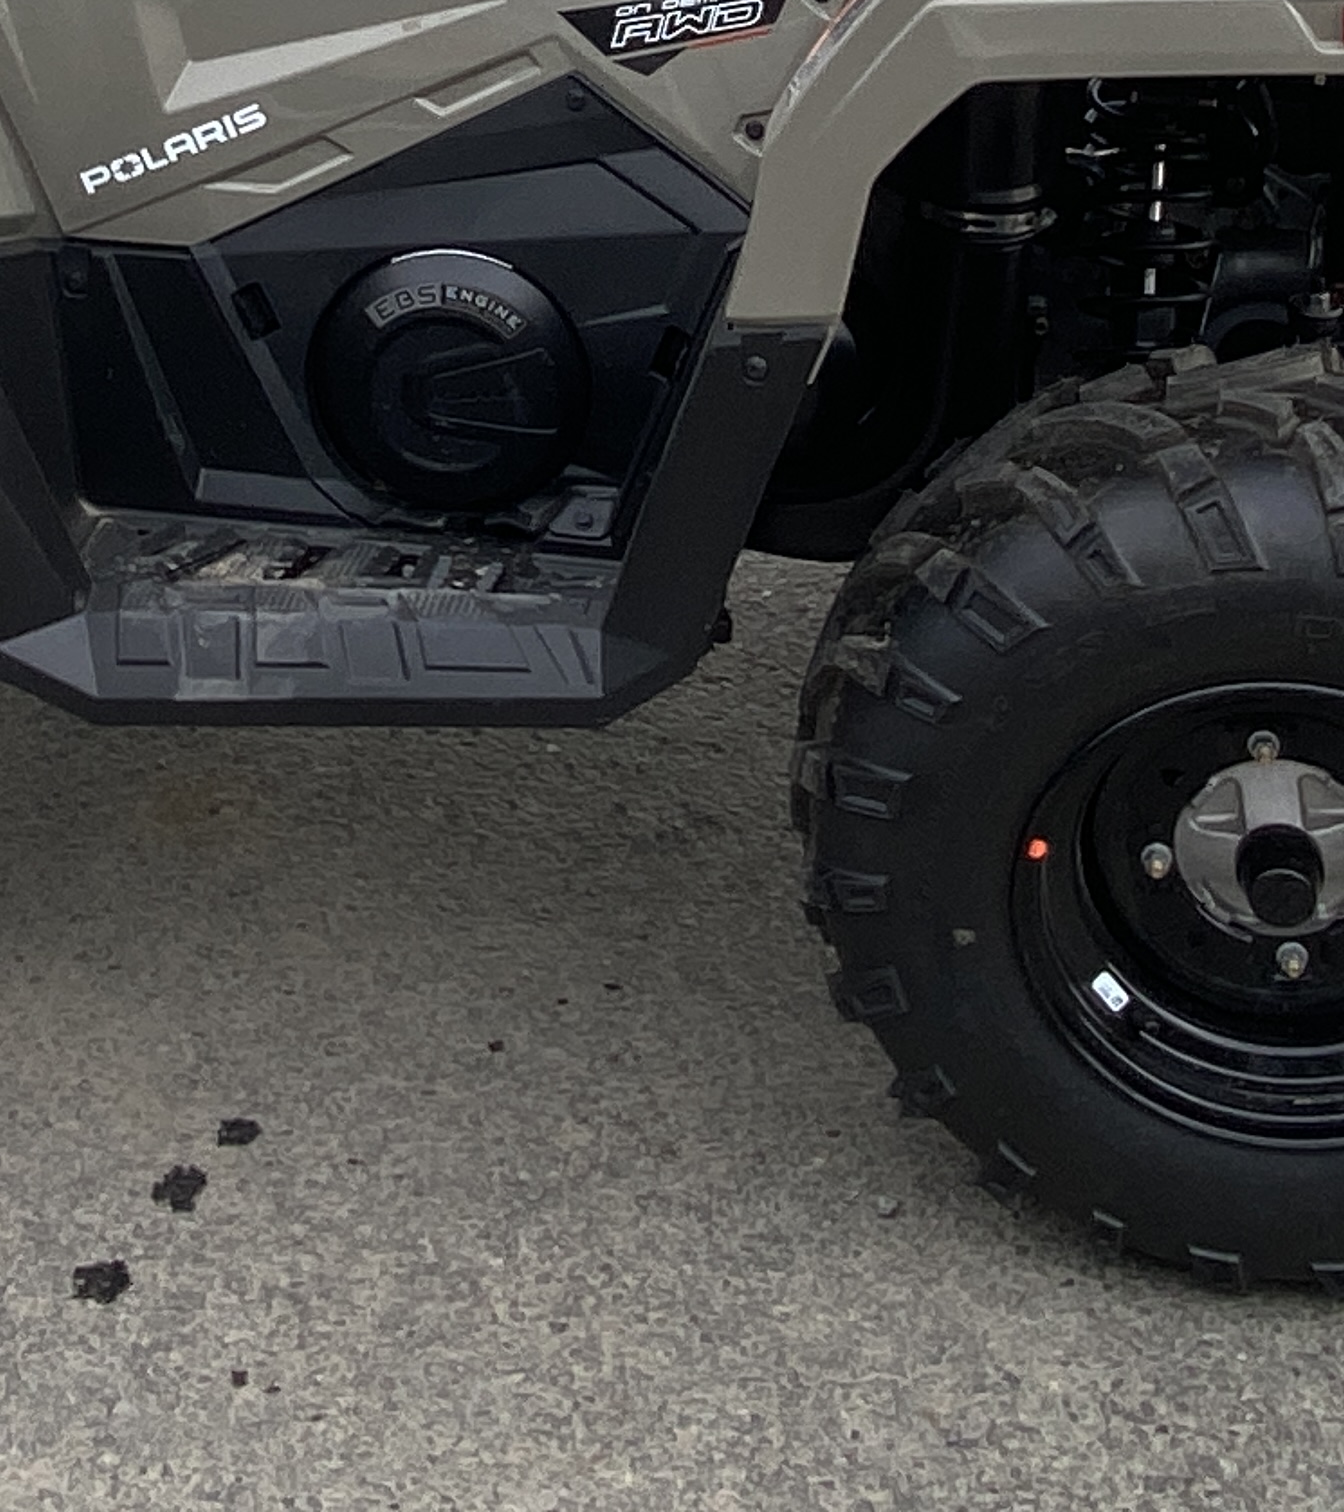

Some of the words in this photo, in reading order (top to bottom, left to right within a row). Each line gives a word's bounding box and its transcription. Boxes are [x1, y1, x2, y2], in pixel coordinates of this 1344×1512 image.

[614, 2, 652, 18] ON
[79, 102, 268, 196] POLARIS
[372, 284, 439, 322] EBS
[444, 285, 523, 331] ENGINE
